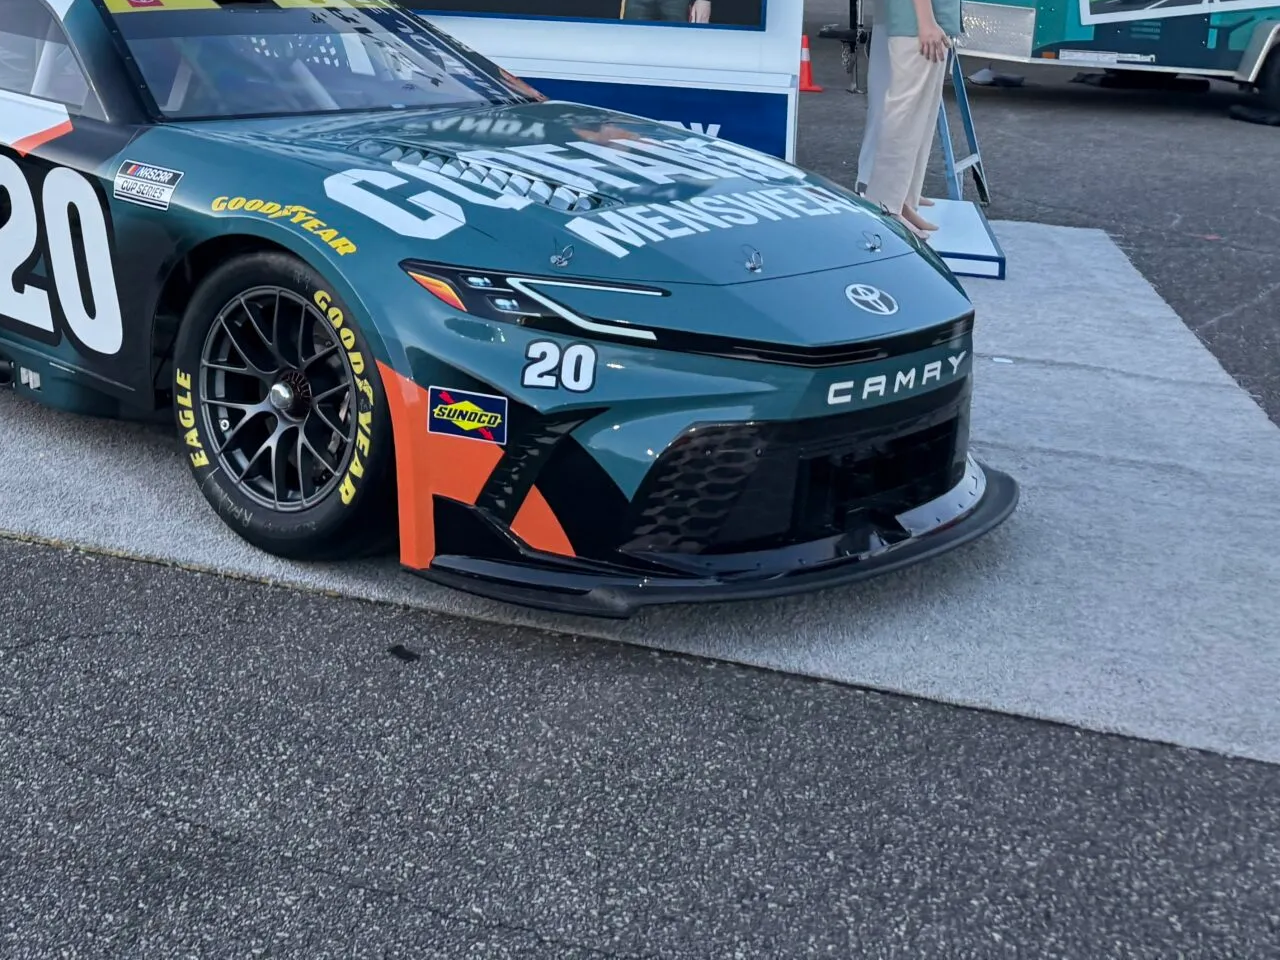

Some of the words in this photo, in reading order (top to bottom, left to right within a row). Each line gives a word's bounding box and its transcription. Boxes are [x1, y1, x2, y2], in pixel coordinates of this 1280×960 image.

[121, 180, 136, 192] CUP
[136, 183, 165, 199] SERIES
[137, 166, 174, 184] NASCAR
[211, 196, 358, 256] GOODYEAR
[524, 341, 595, 392] 20
[175, 367, 210, 469] EAGLE
[313, 290, 376, 506] GOODYEAR
[436, 406, 499, 426] SUNOCO
